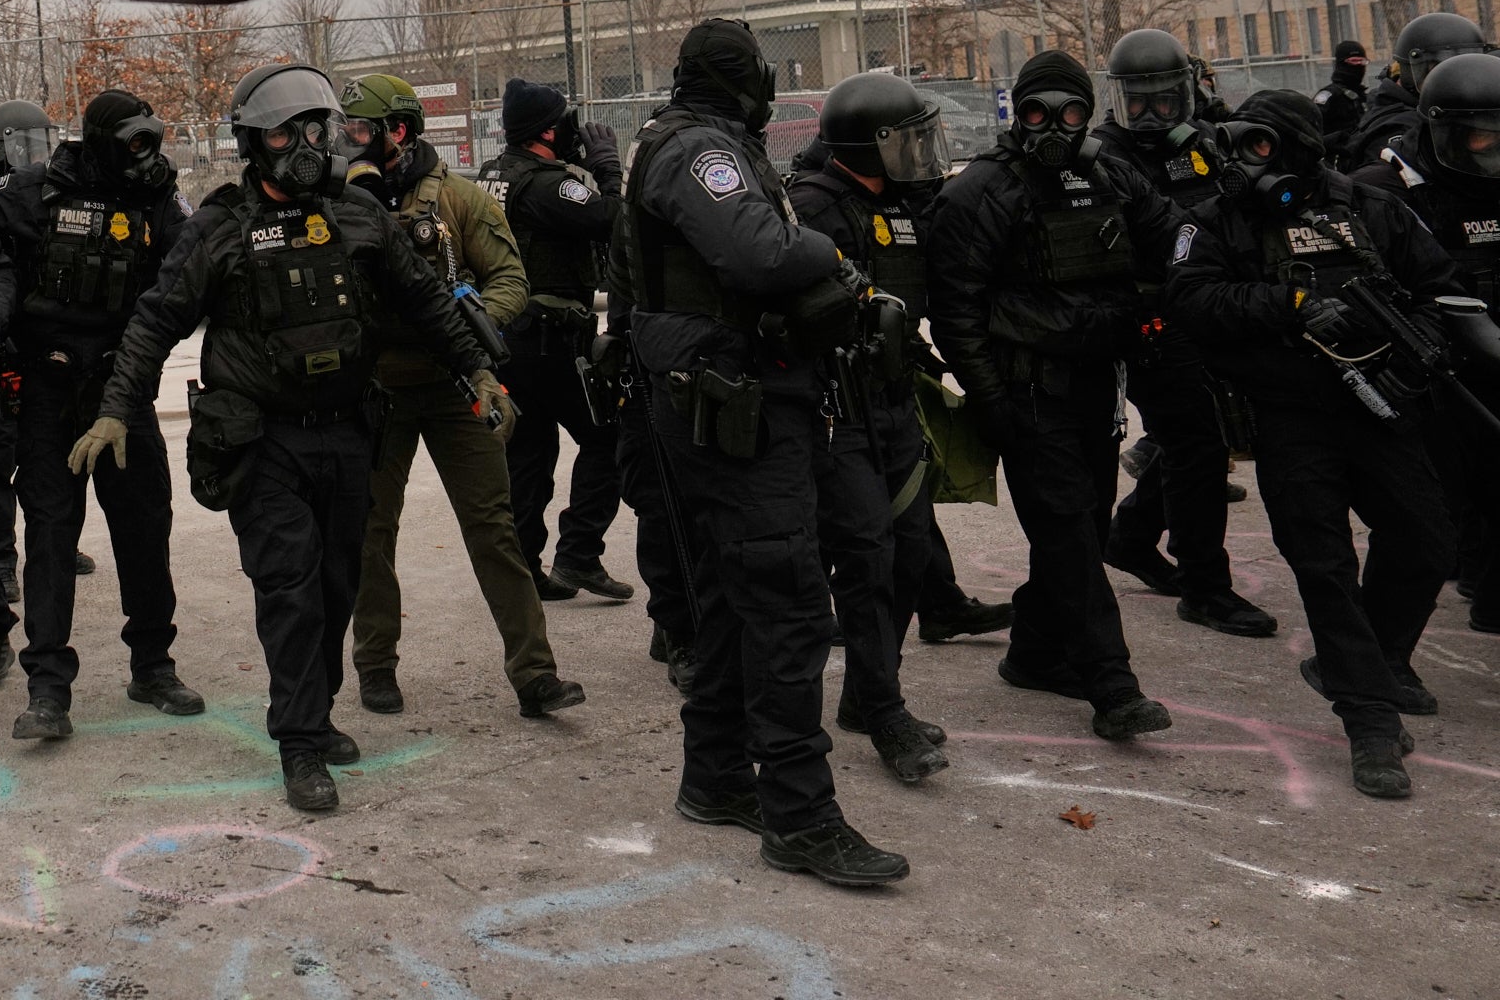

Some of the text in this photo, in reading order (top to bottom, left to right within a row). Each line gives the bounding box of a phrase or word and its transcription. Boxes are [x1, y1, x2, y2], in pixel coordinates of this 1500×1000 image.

[58, 208, 92, 225] POLICE
[890, 218, 915, 234] POLICE
[1463, 219, 1500, 234] POLICE
[252, 226, 285, 243] POLICE
